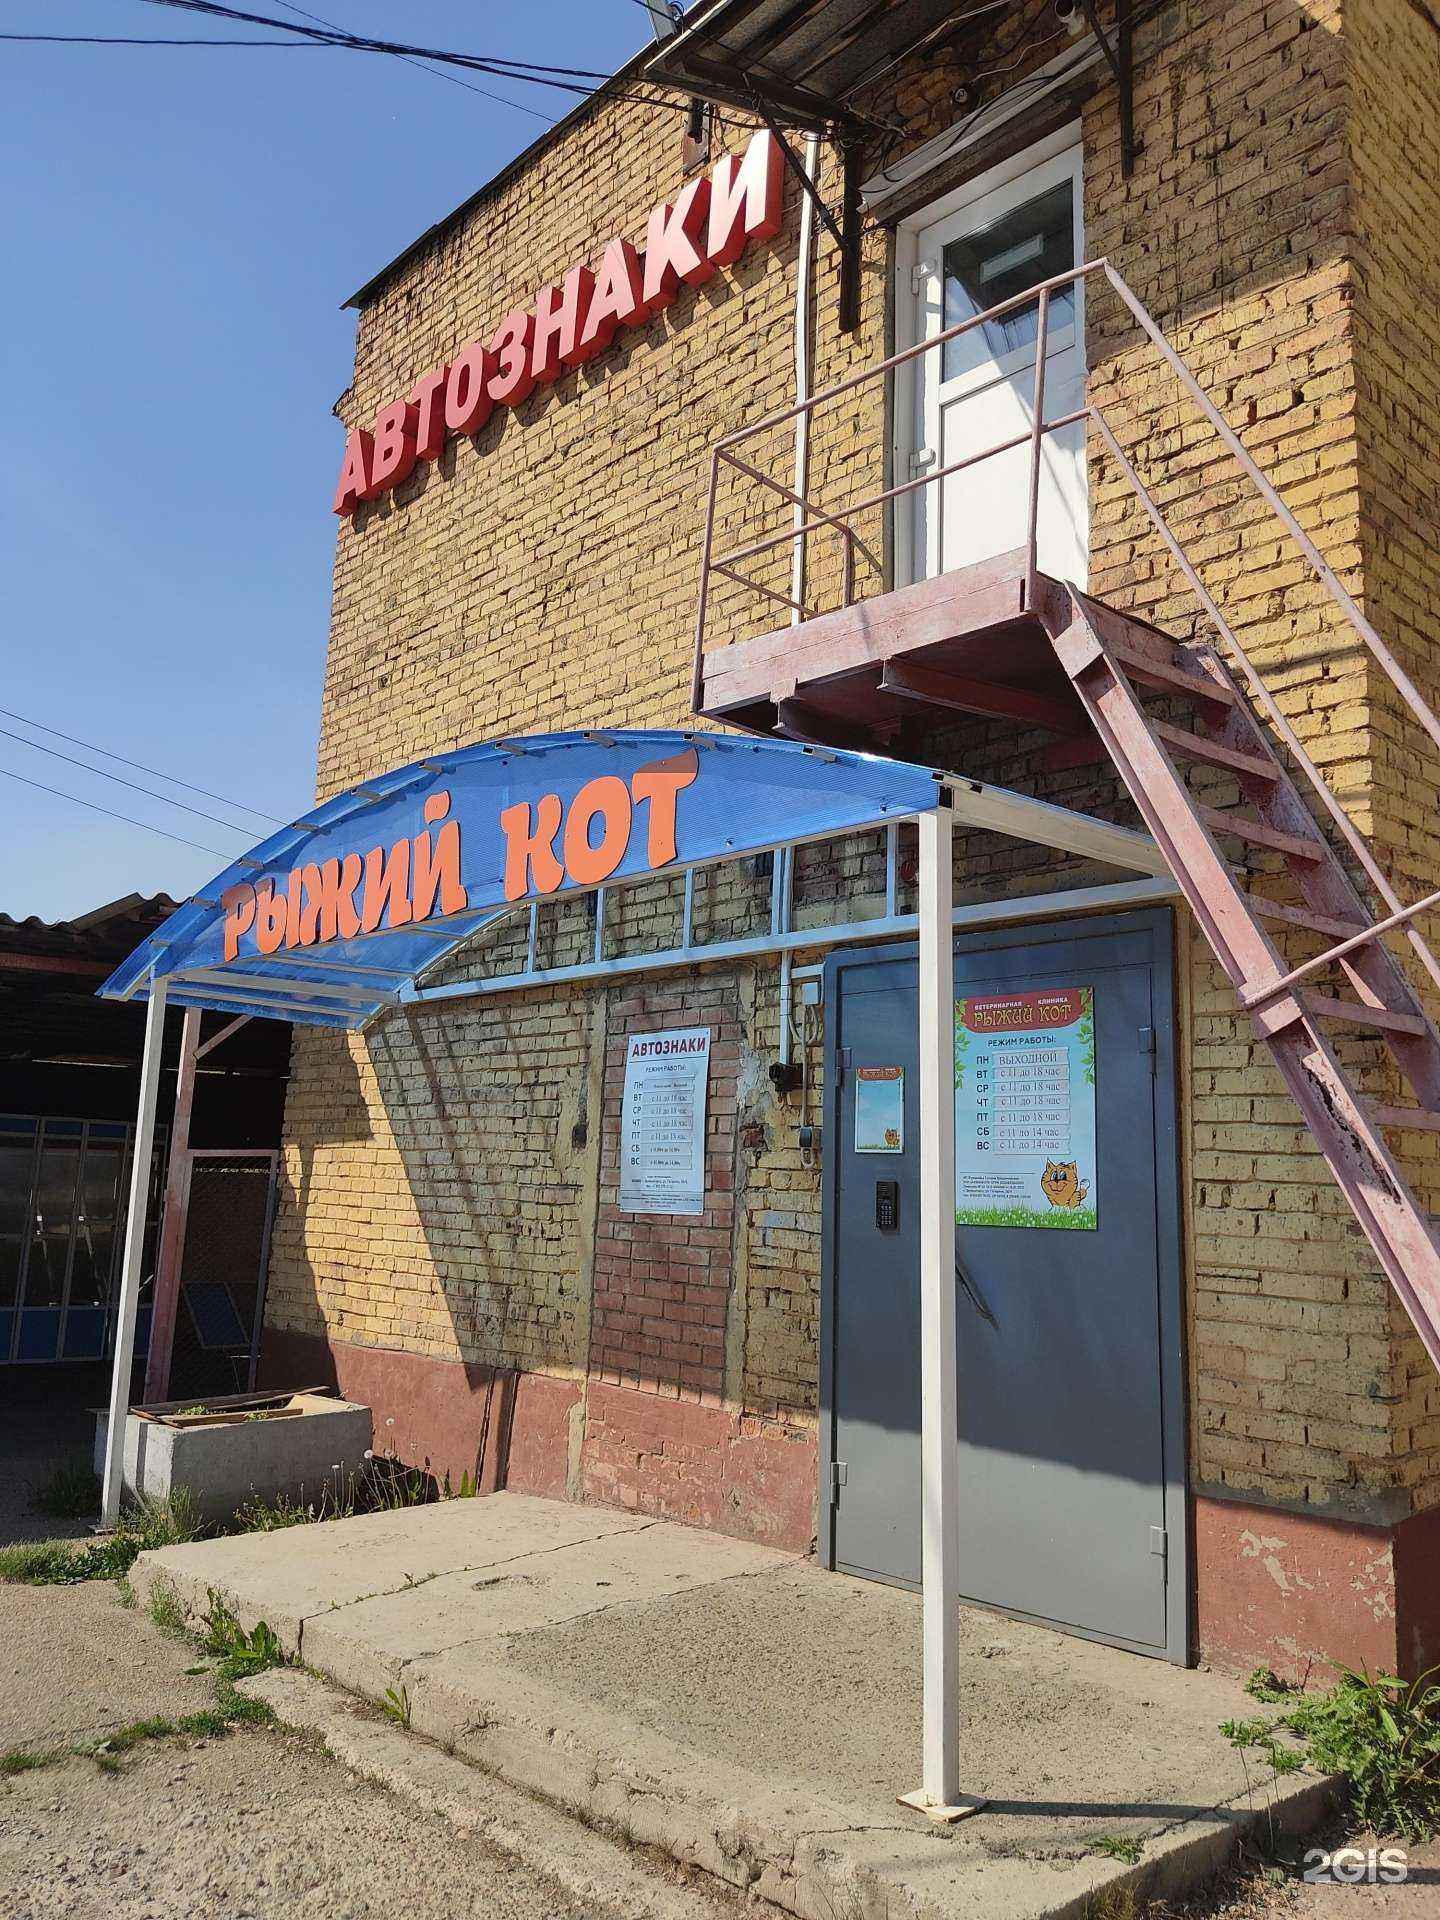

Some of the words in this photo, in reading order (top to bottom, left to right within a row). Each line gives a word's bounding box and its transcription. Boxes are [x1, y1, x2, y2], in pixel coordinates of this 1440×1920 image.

[334, 129, 784, 516] АВТОЗНАКИ
[222, 789, 468, 961] РЫЖИЙ
[501, 747, 700, 901] КОТ
[975, 1001, 1022, 1011] ВЕТЕРИНАРНАЯ
[1037, 997, 1068, 1005] КЛИНИКА
[974, 1005, 1033, 1027] РЫЖИЙ
[1039, 1004, 1072, 1022] КОТ
[988, 1038, 1018, 1047] РЕЖИМ
[1020, 1036, 1057, 1044] РАБОТЫ:
[632, 1037, 705, 1057] АВТОЗНАКИ
[977, 1055, 989, 1064] ПН
[999, 1053, 1057, 1065] ВЫХОДНОЙ
[976, 1070, 988, 1079] ВТ
[1020, 1069, 1031, 1078] до
[1033, 1068, 1043, 1076] 18
[1046, 1068, 1060, 1076] час
[634, 1081, 643, 1089] ПН
[976, 1084, 989, 1093] СР
[1020, 1084, 1031, 1093] до
[1033, 1082, 1043, 1091] 18
[976, 1098, 988, 1106] ЧТ
[1021, 1098, 1031, 1106] до
[1034, 1096, 1043, 1105] 18
[1046, 1097, 1060, 1105] час
[976, 1113, 988, 1122] ПТ
[1019, 1114, 1031, 1122] до
[1033, 1112, 1043, 1121] 18
[632, 1131, 640, 1139] ПТ
[976, 1127, 989, 1136] СБ
[1019, 1129, 1030, 1137] до
[1033, 1128, 1042, 1136] 14
[1045, 1128, 1059, 1136] час
[976, 1141, 990, 1150] ВС
[1019, 1141, 1029, 1149] до
[1032, 1140, 1042, 1148] 14
[1045, 1141, 1059, 1149] час
